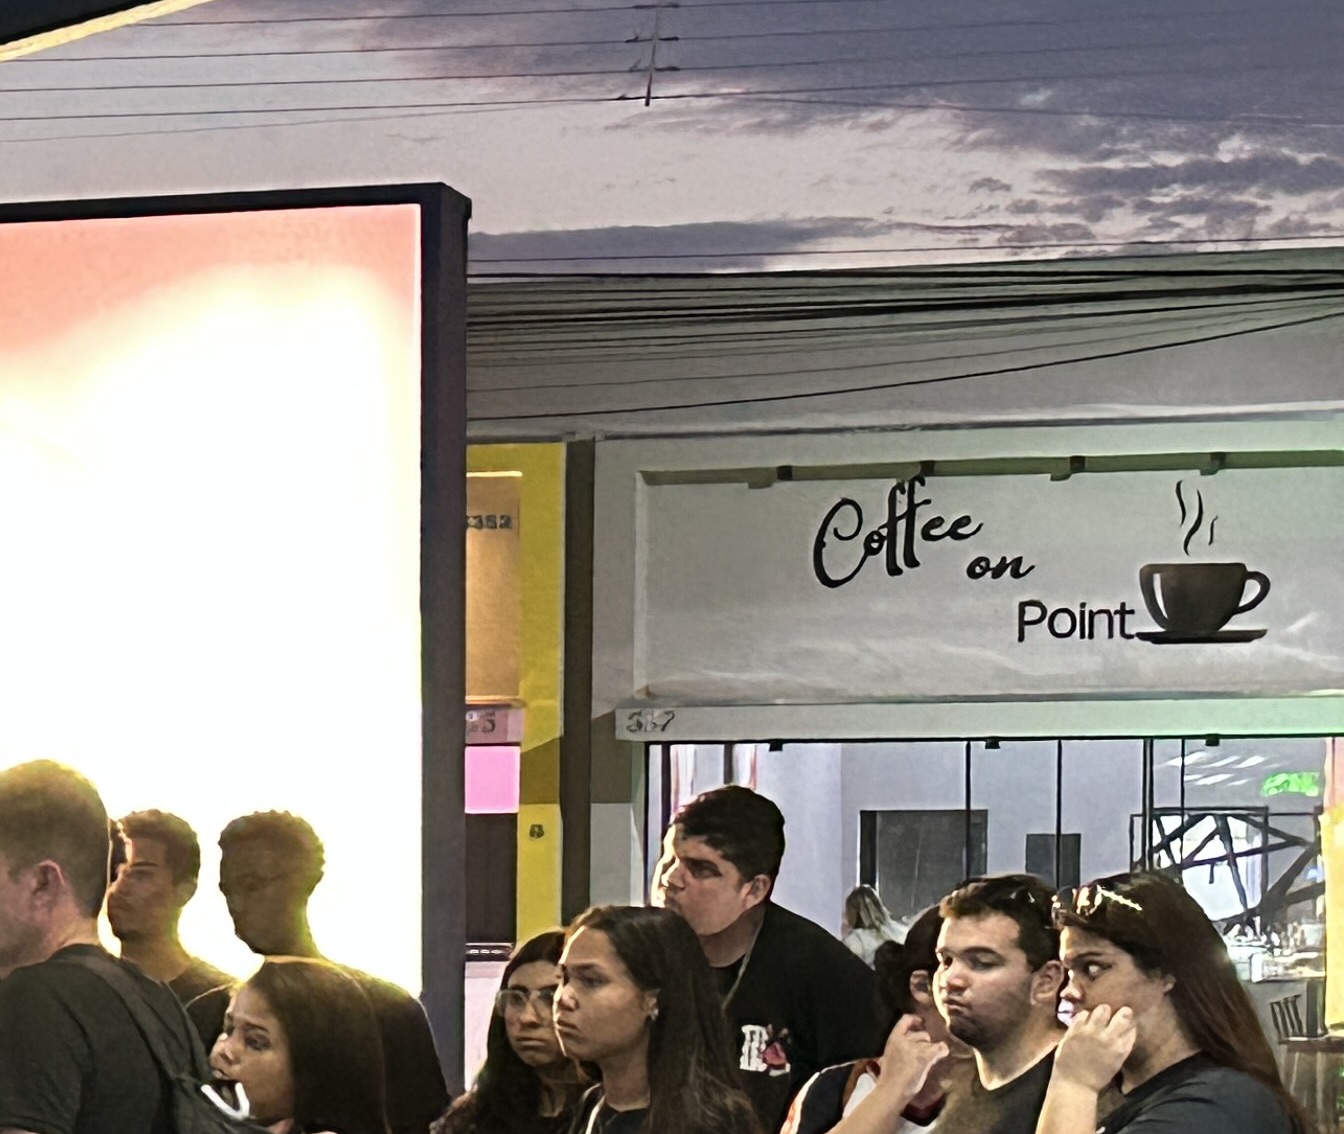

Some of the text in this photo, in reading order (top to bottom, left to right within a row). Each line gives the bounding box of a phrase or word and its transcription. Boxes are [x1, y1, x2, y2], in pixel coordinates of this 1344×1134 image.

[813, 475, 983, 588] Coffee
[966, 553, 1036, 580] on
[1017, 600, 1136, 643] Point
